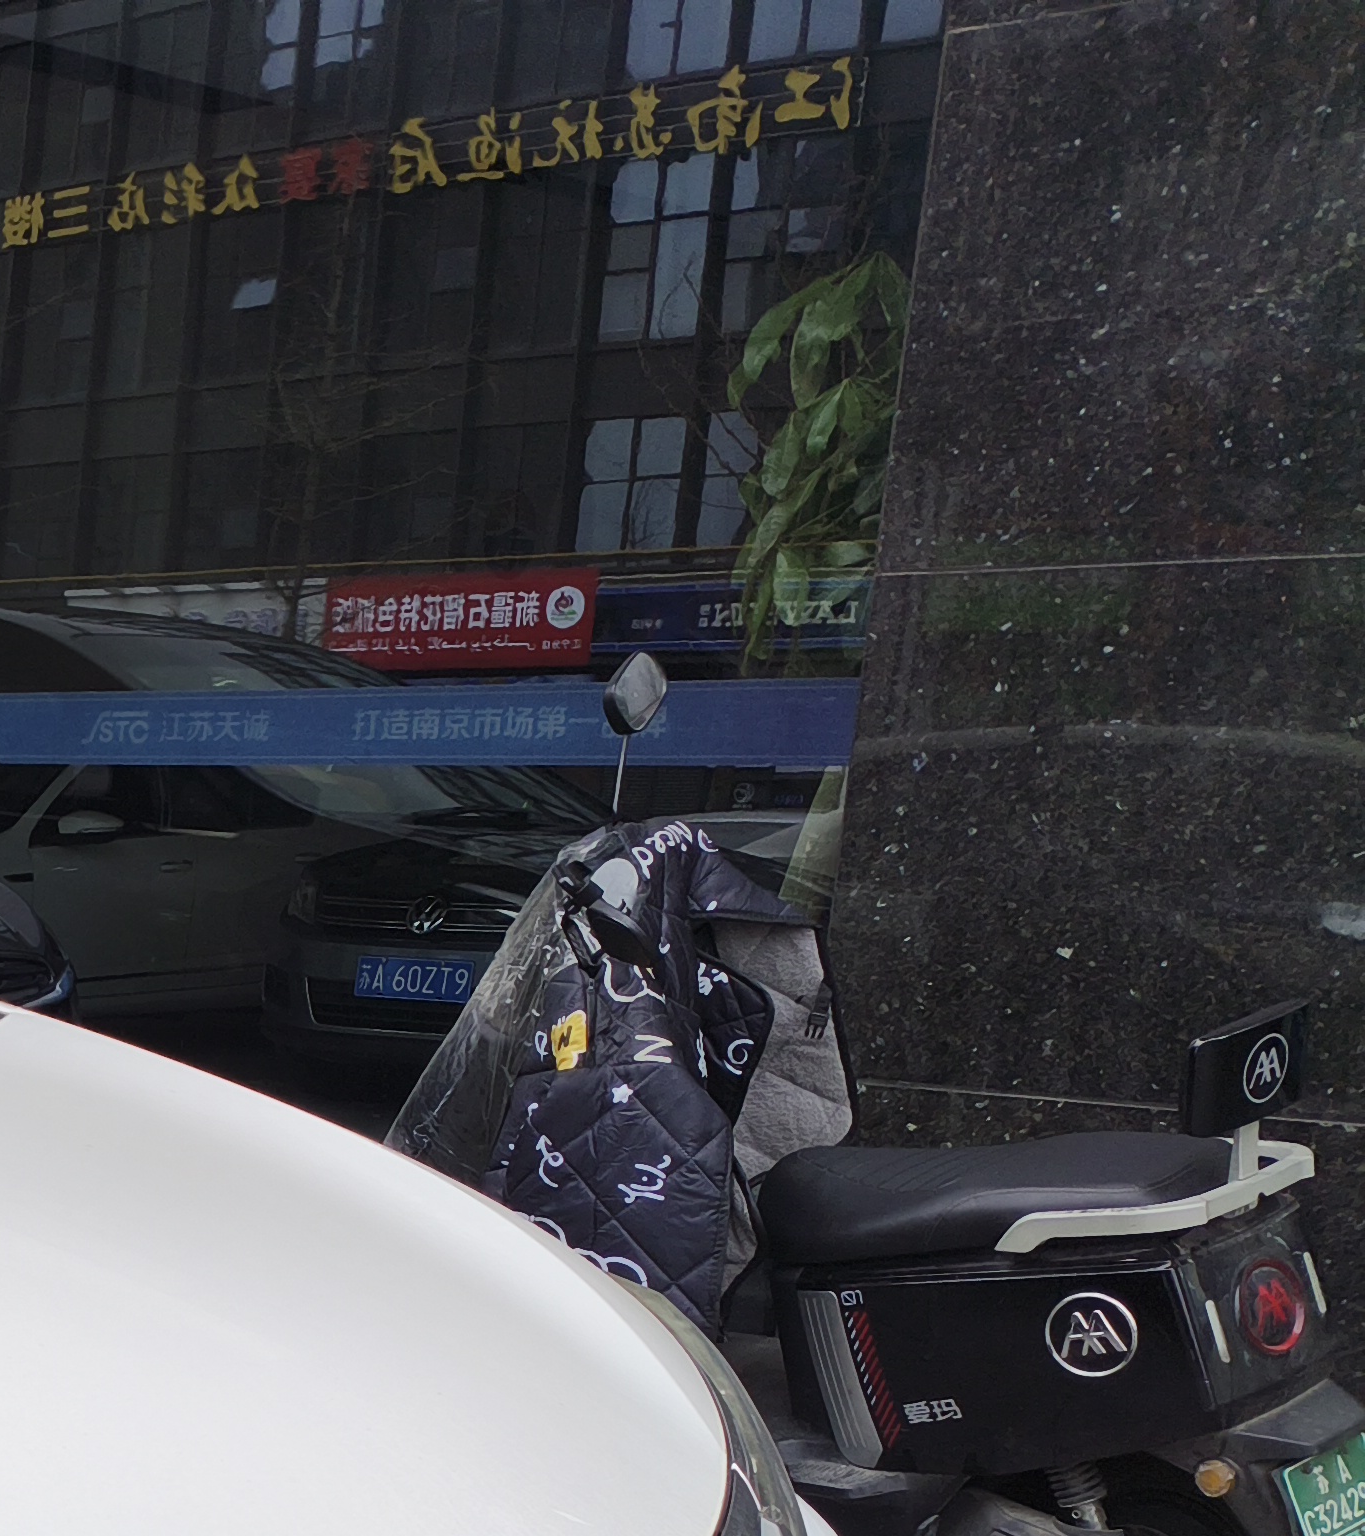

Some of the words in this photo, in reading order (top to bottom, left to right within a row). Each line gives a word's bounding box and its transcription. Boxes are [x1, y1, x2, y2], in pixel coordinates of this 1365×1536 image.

[158, 708, 271, 743] 江苏天诚
[902, 1396, 964, 1425] 爱玛
